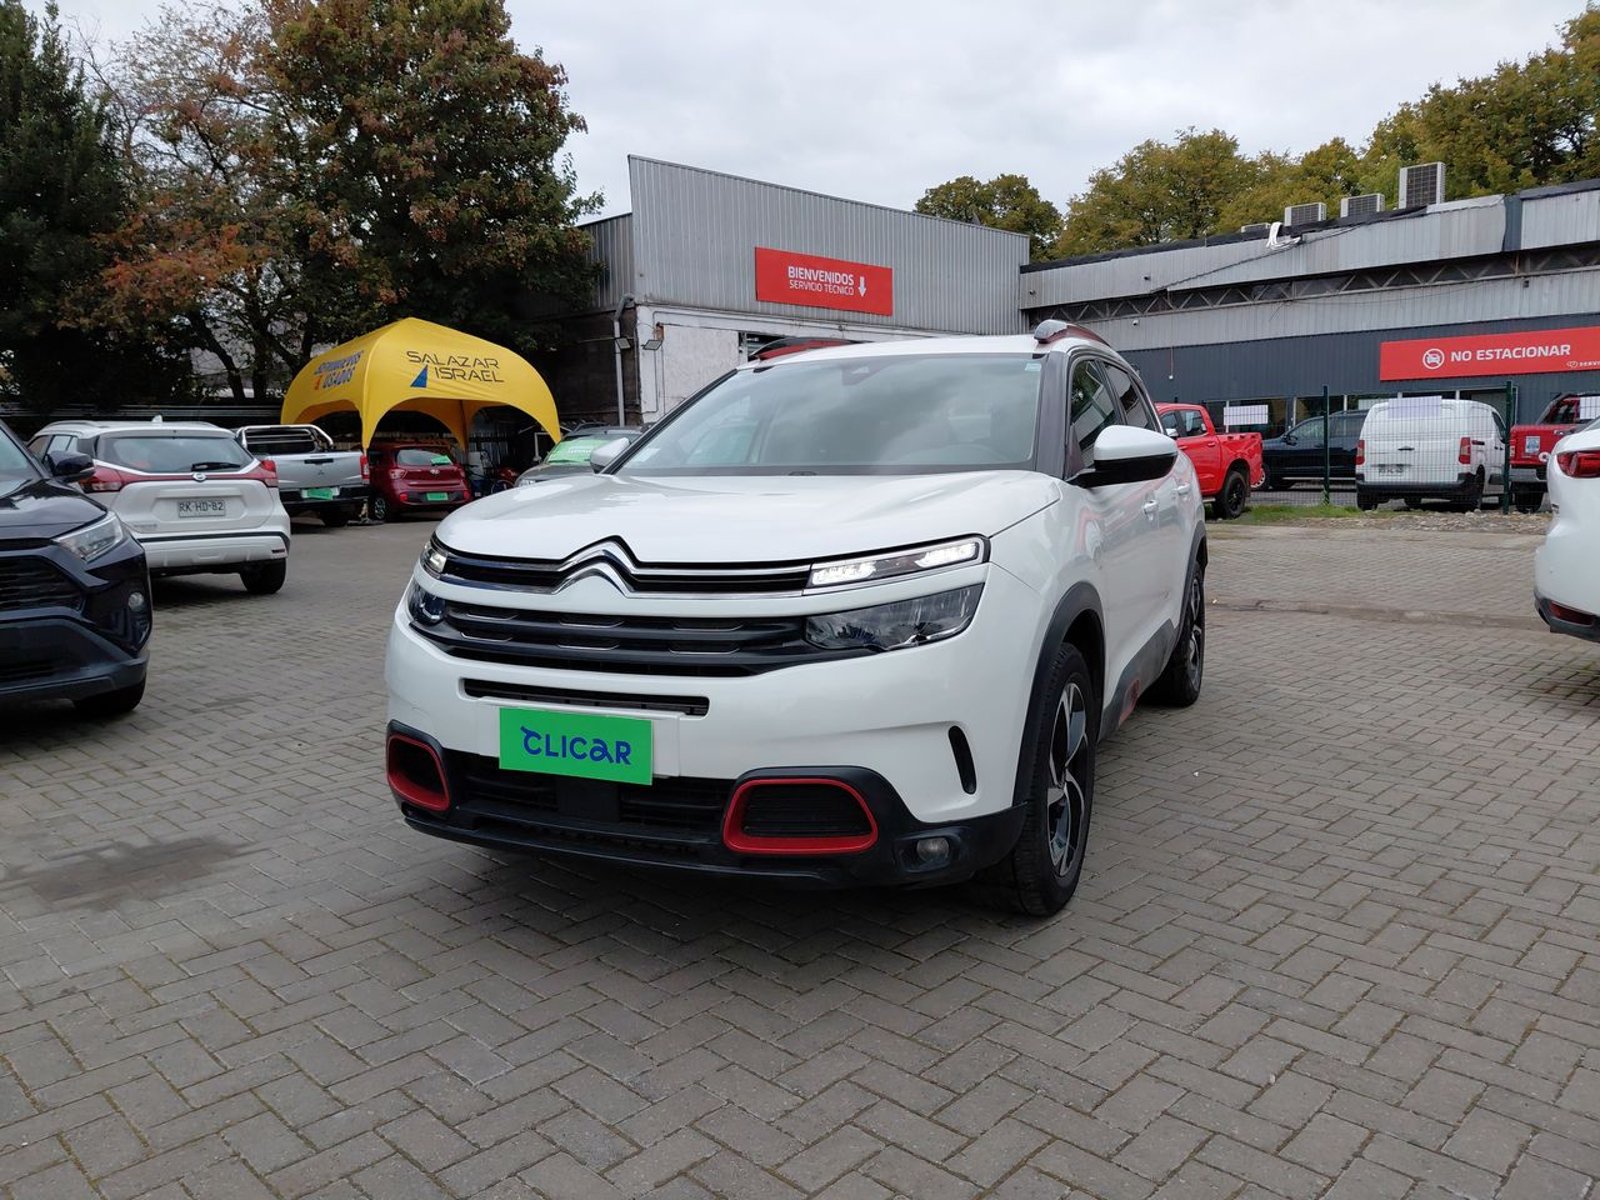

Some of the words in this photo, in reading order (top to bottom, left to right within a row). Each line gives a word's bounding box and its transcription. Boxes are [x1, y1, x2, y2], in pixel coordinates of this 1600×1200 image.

[787, 265, 854, 286] BIENVENIDOS
[789, 279, 822, 292] SERVICIO
[406, 350, 499, 369] SALAZAR
[1451, 350, 1472, 362] NO
[1476, 344, 1571, 361] ESTACIONAR
[434, 366, 505, 383] ISRAEL
